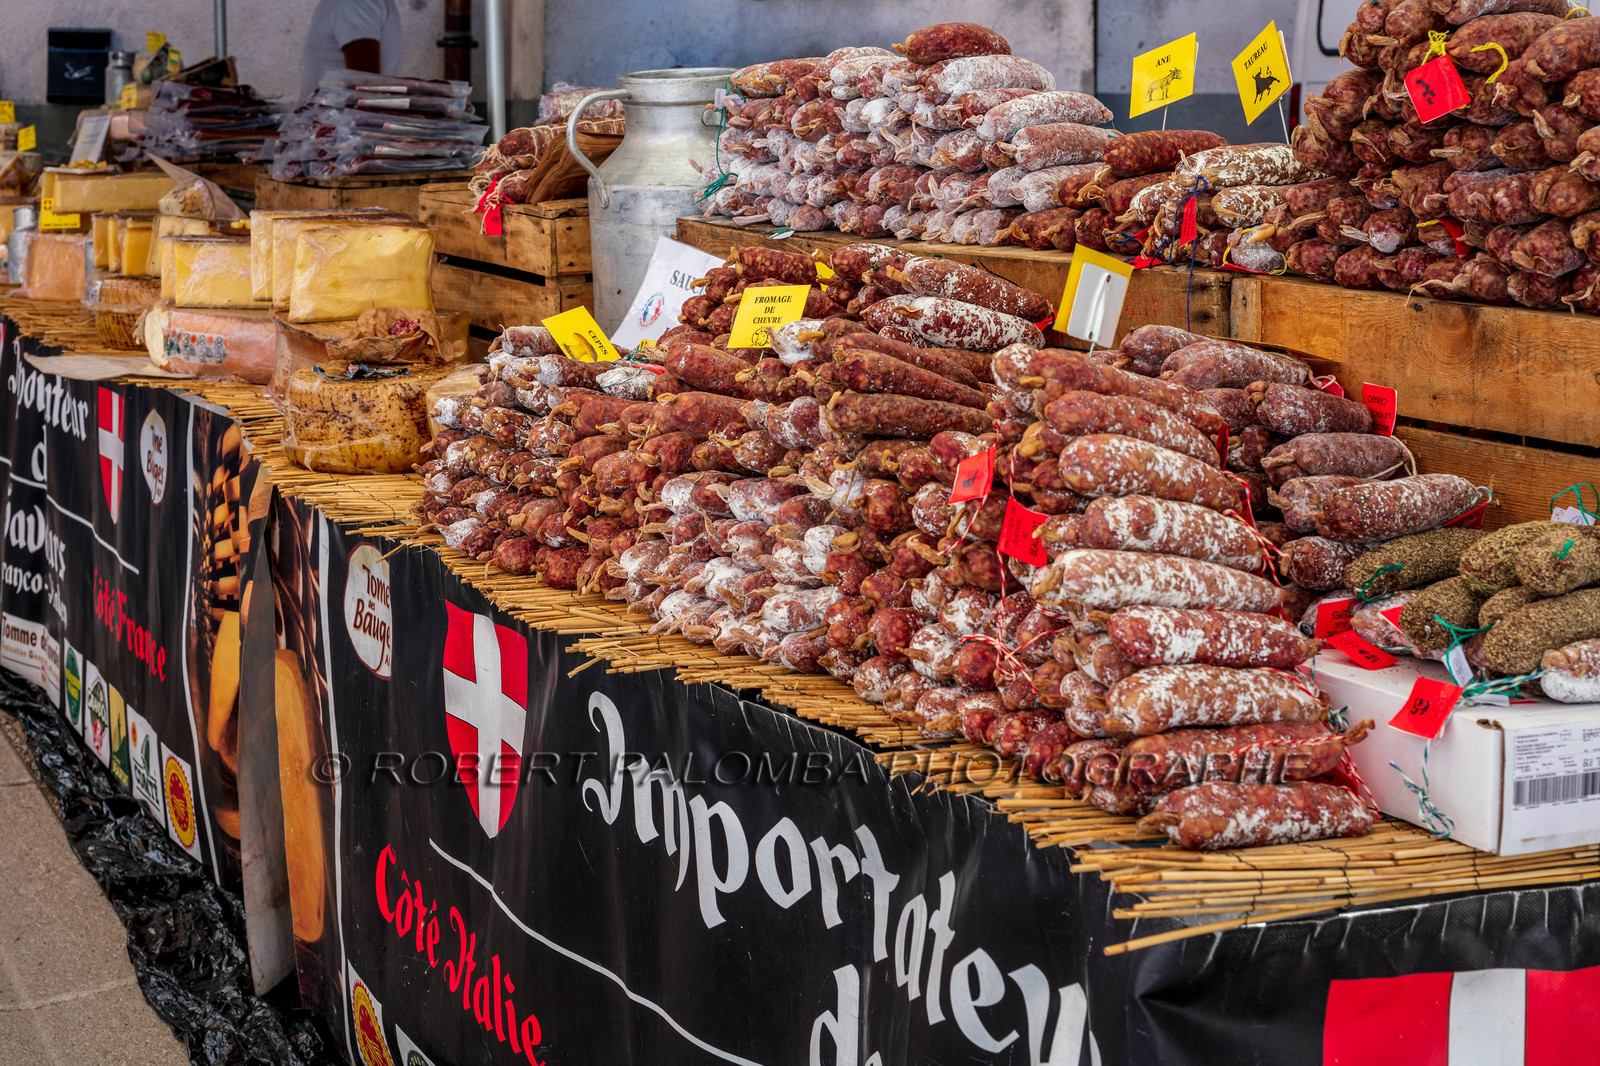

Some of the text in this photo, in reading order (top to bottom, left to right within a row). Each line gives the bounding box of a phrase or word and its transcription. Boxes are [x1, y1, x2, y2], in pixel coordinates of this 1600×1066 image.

[1155, 54, 1171, 67] ANE
[1243, 40, 1268, 70] TAUREAU
[754, 295, 792, 304] FROMAGE
[763, 306, 775, 314] DE
[752, 316, 782, 324] CHEVRE
[588, 330, 608, 355] CEPES
[362, 564, 390, 609] Tome
[2, 616, 37, 647] Tomme
[115, 588, 166, 682] France
[353, 598, 390, 649] Bauge
[582, 691, 1101, 1066] Importateu
[375, 843, 440, 969] Côté
[444, 906, 546, 1066] Italie
[809, 963, 882, 1066] d
